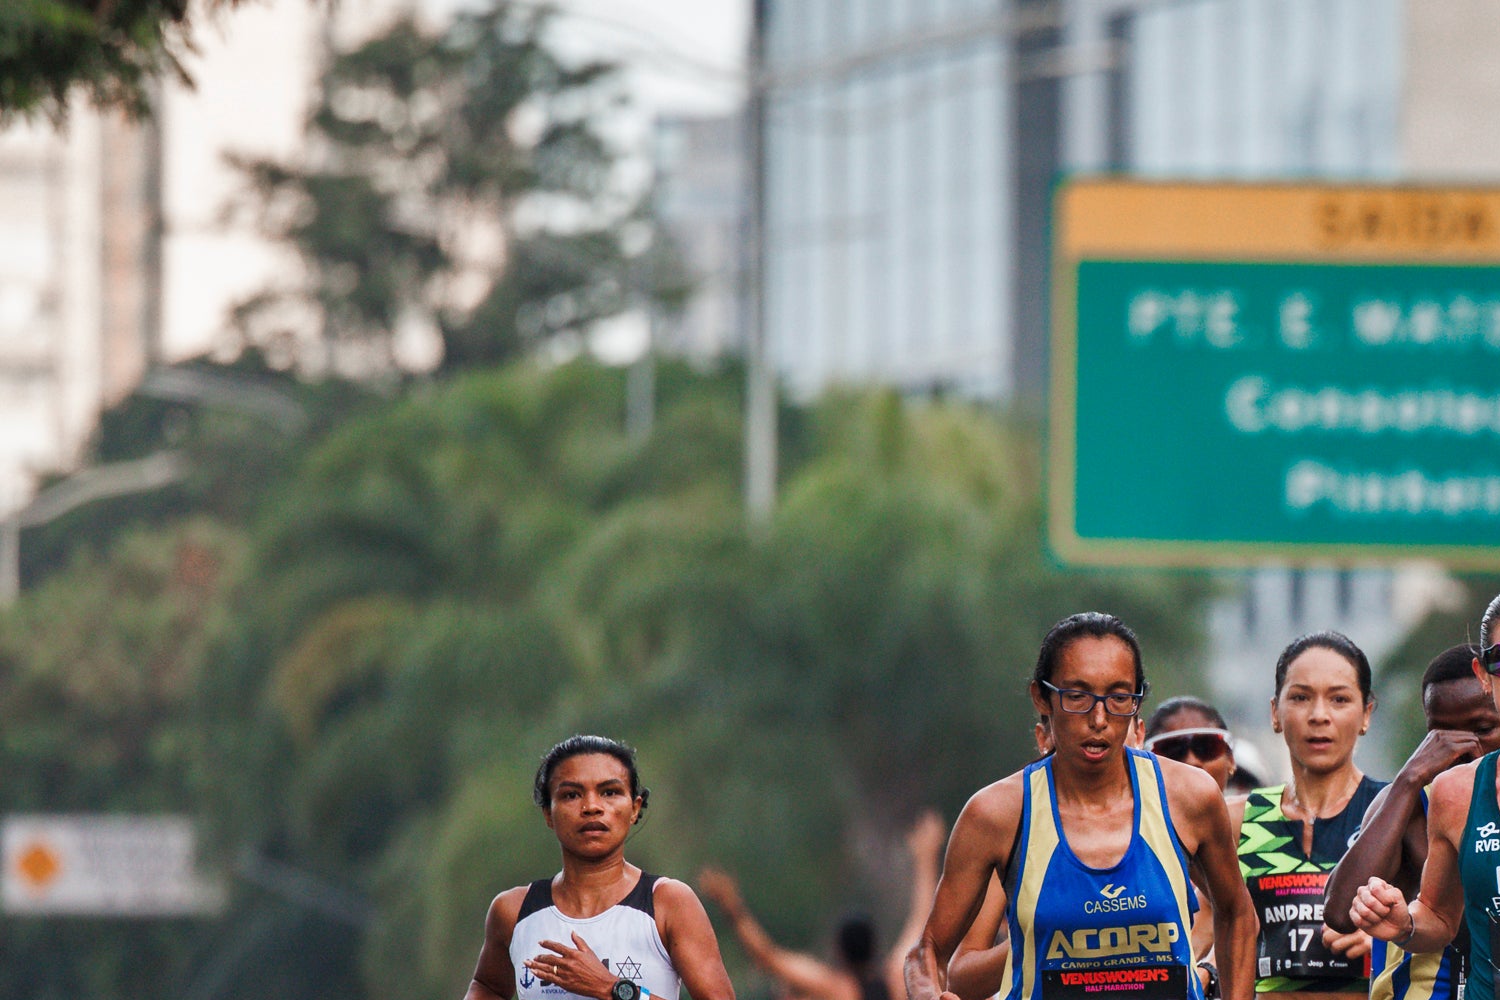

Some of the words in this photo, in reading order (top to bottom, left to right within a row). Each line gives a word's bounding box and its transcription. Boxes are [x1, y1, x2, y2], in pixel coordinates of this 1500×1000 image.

[1475, 838, 1500, 853] RVB
[1259, 874, 1328, 890] VENUSWOM
[1290, 887, 1325, 895] MARATHO
[1084, 894, 1147, 914] CASSEMS
[1265, 904, 1325, 923] ANDRE
[1046, 922, 1180, 960] ACORP
[1288, 928, 1314, 952] 17
[1103, 957, 1146, 967] GRANDE
[1156, 954, 1173, 963] MS
[1060, 969, 1169, 985] VENUSWOMEN'S
[1104, 982, 1145, 991] MARATHON
